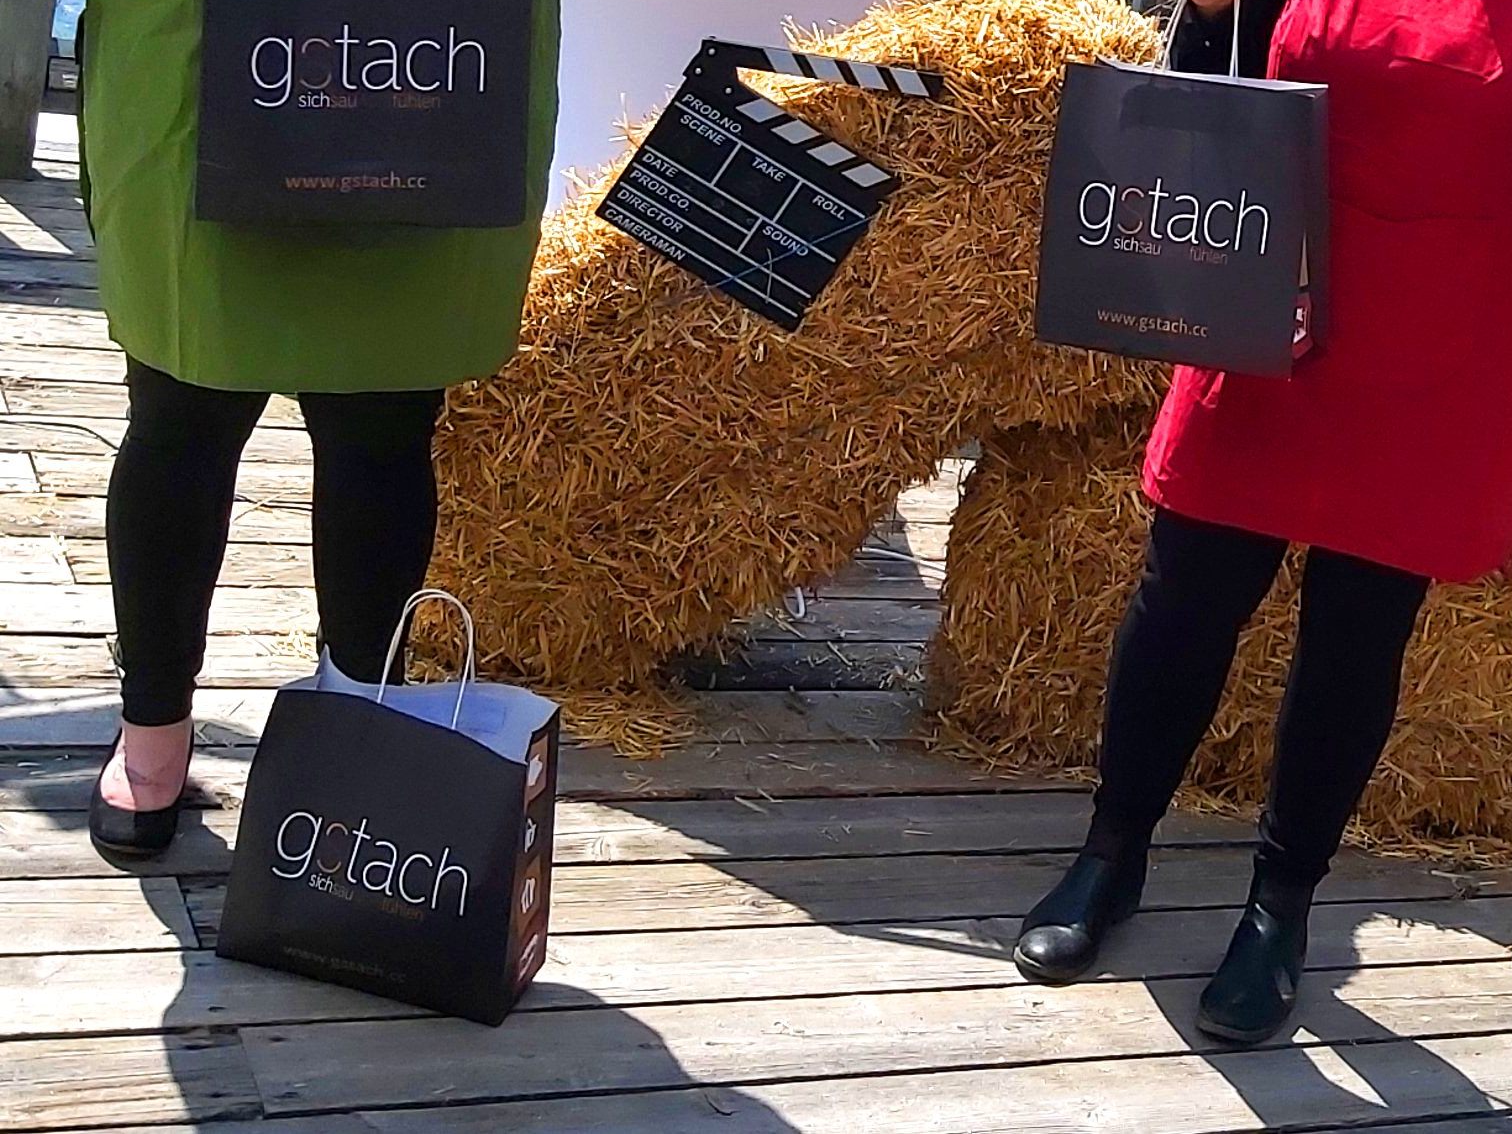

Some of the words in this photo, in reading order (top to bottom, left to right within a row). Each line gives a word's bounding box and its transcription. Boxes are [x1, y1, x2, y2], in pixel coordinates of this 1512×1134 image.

[680, 114, 726, 146] SCENE
[682, 93, 743, 136] PROD.NO.
[642, 152, 679, 178] DATE
[751, 156, 786, 183] TAKE
[285, 172, 427, 193] www.gstach.cc
[630, 169, 690, 212] PROD.CO.
[617, 188, 684, 234] DIRECTOR
[812, 194, 846, 221] ROLL
[604, 208, 687, 262] CAMERAMAN
[761, 225, 810, 258] SOUND
[1097, 307, 1209, 339] www.gstach.cc
